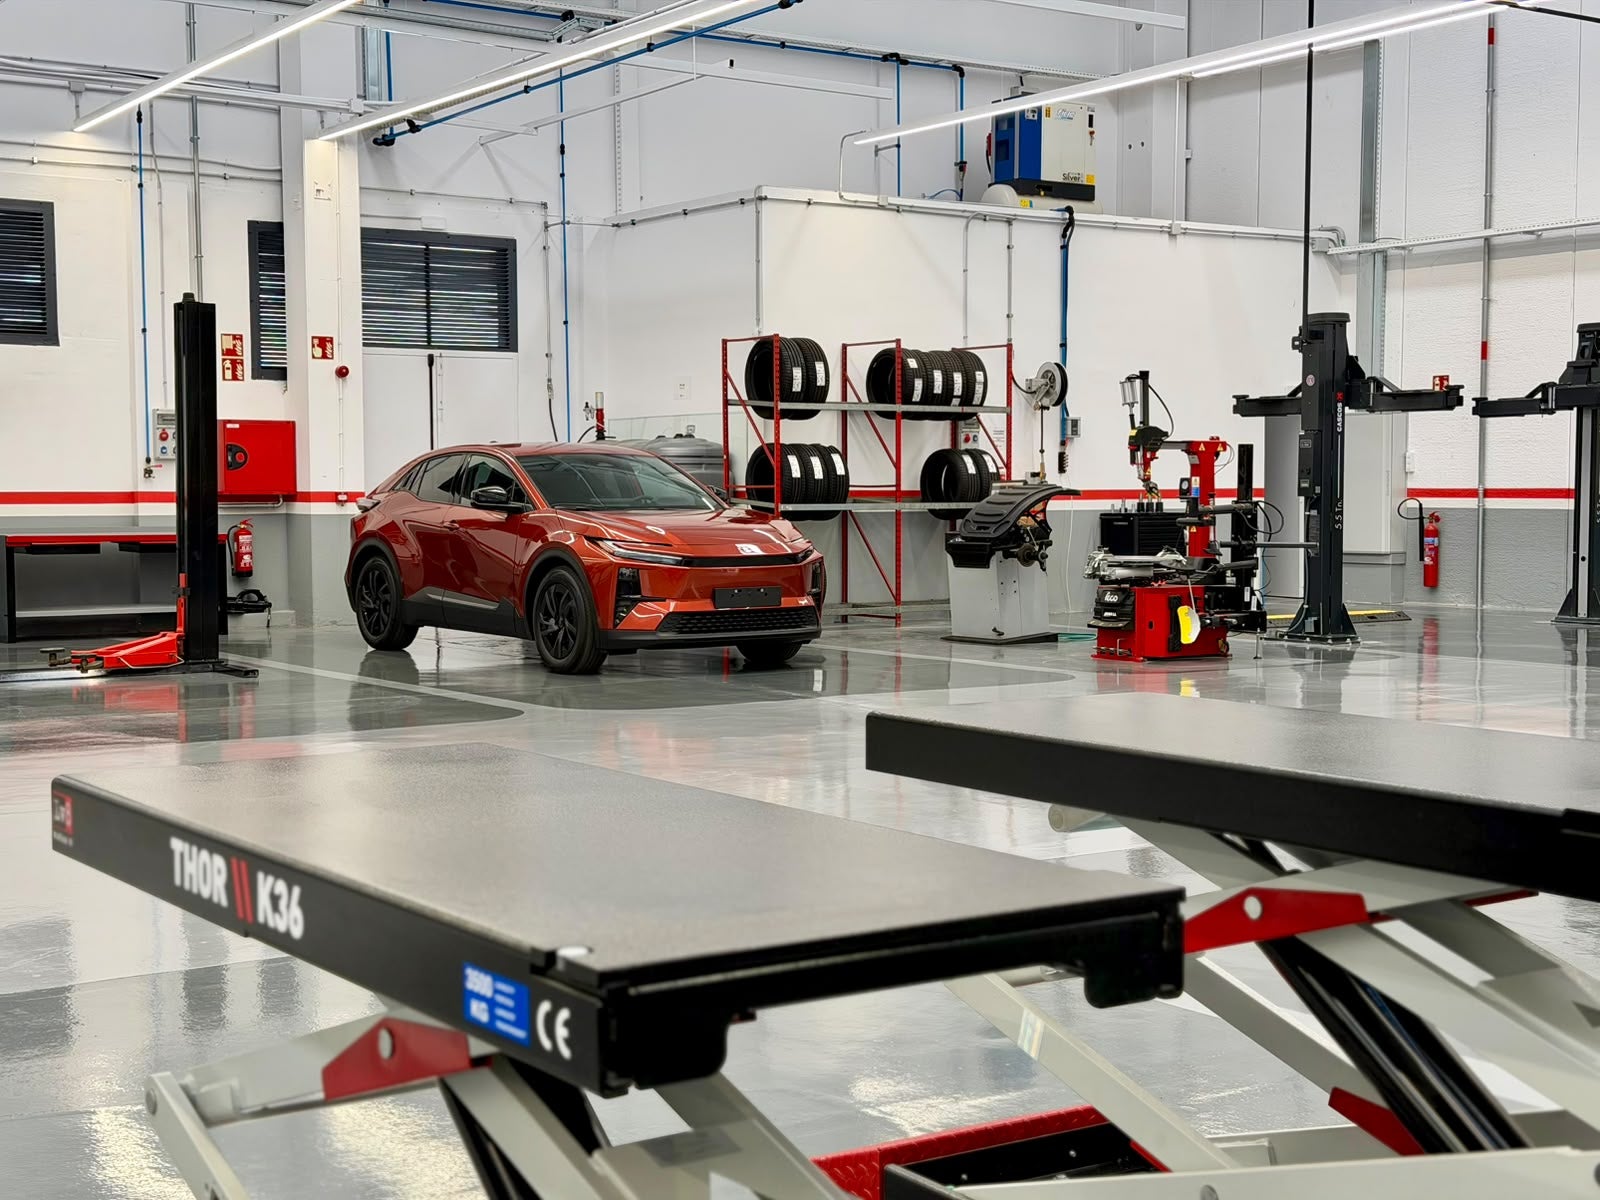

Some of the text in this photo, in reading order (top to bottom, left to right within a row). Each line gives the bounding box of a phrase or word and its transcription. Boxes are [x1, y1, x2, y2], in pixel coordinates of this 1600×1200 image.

[170, 836, 228, 908] THOR
[256, 869, 304, 940] K36
[536, 999, 572, 1060] CE
